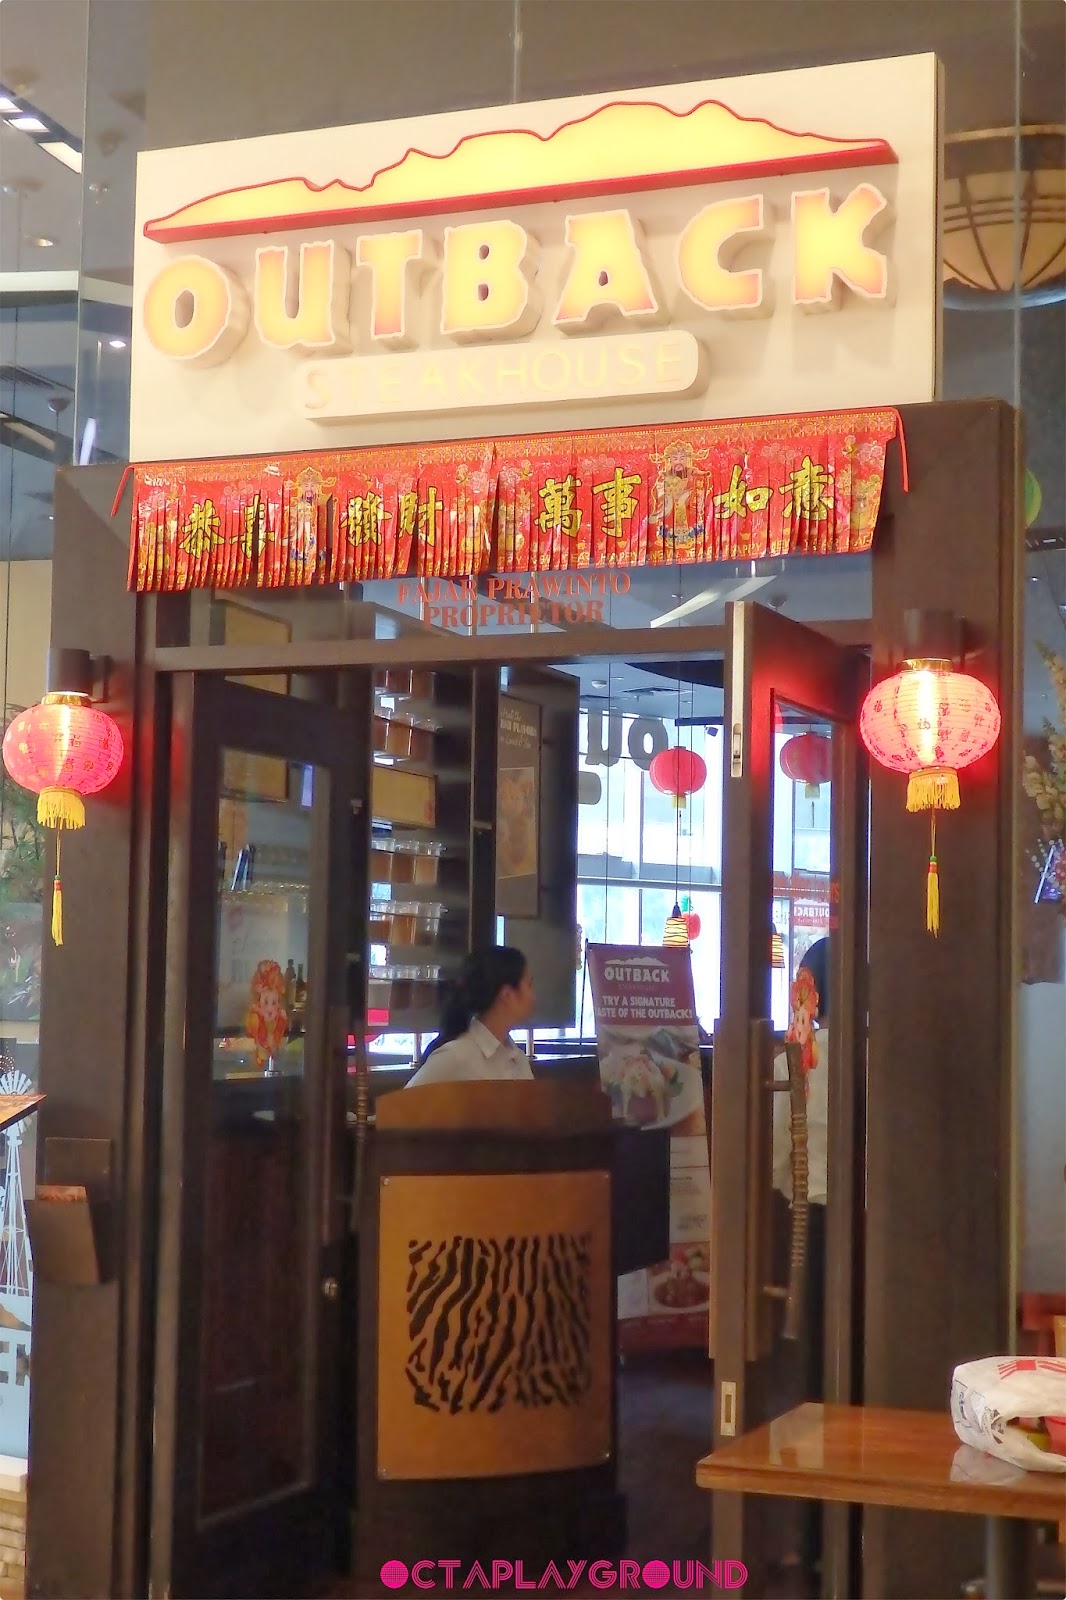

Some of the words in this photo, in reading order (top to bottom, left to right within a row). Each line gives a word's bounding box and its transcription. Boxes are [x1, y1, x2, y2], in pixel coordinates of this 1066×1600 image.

[142, 182, 889, 362] OUTBACK
[304, 341, 682, 410] STEAKHOUSE
[396, 576, 478, 606] FAJAR
[487, 571, 631, 601] PRAWINTO
[423, 599, 604, 629] PROPRIETOR
[604, 966, 670, 983] OUTBACK
[602, 995, 620, 1006] TRY
[621, 996, 629, 1006] A
[630, 996, 676, 1008] SIGNATURE
[618, 1008, 629, 1018] OF
[631, 1008, 646, 1019] THE
[648, 1008, 692, 1019] OUTBACK!
